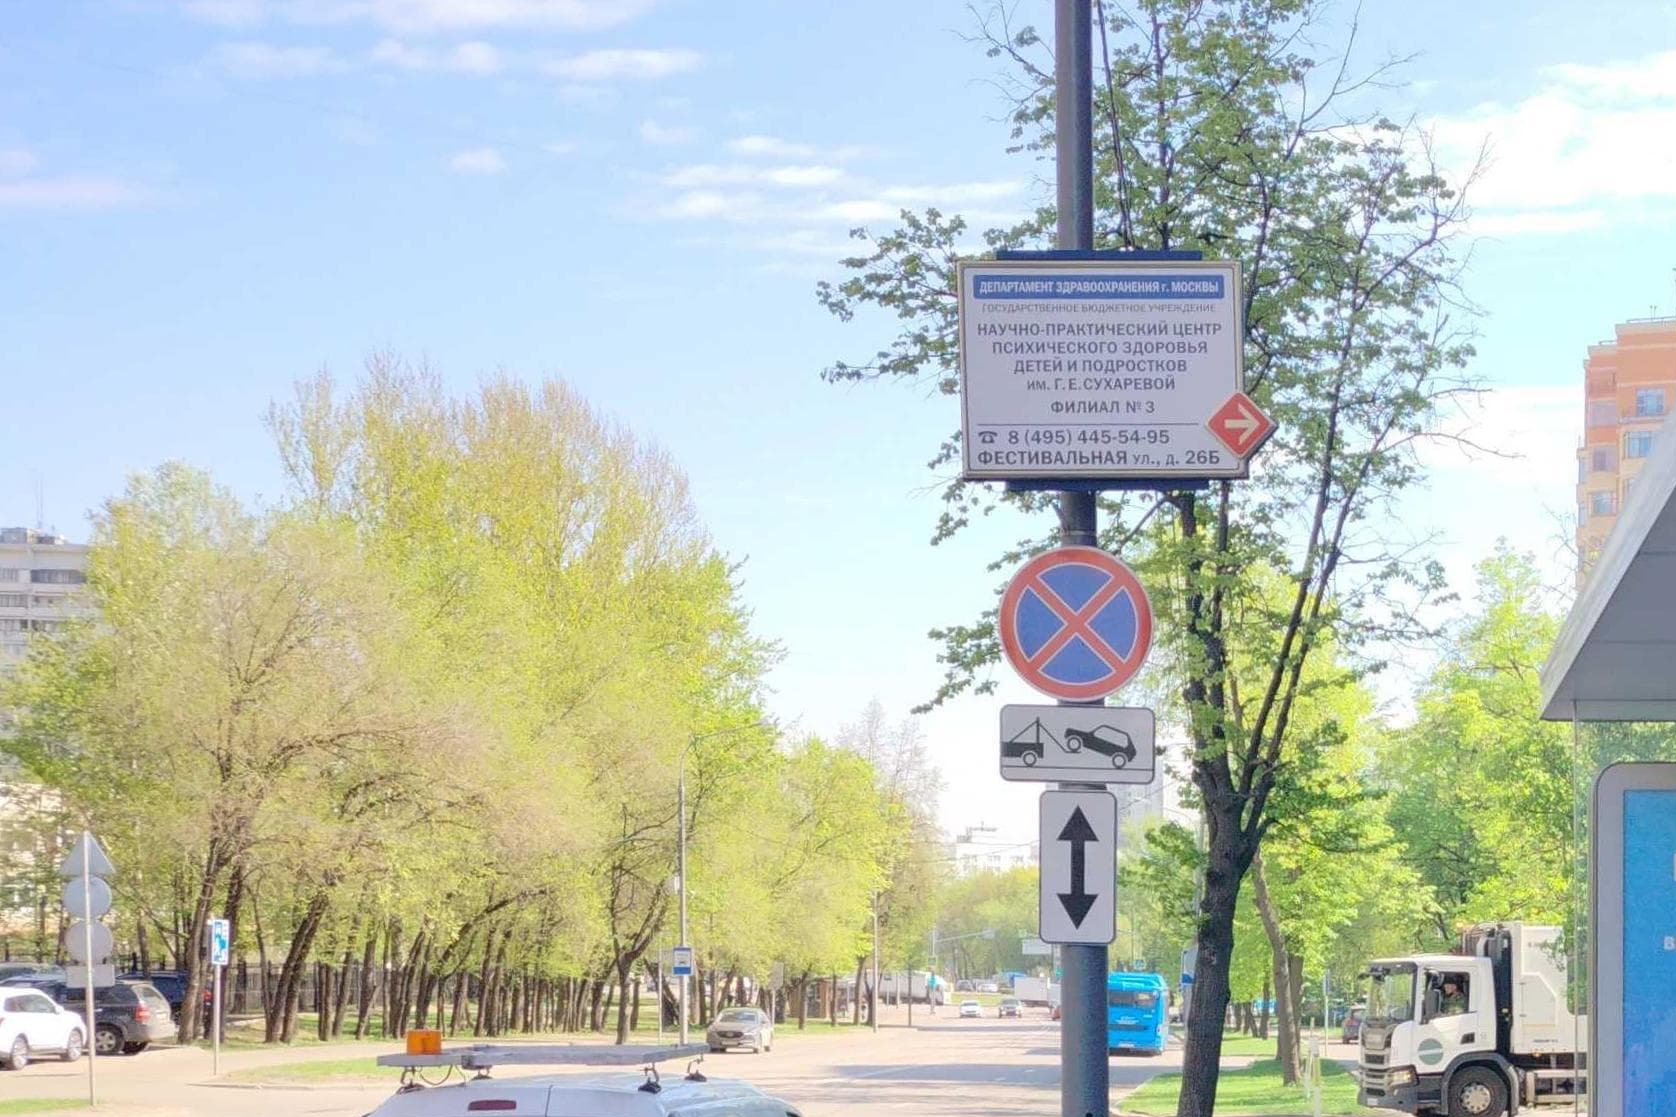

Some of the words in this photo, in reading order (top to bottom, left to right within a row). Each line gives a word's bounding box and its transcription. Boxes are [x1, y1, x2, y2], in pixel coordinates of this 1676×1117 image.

[979, 281, 1053, 294] ДЕПАРТАМЕНТ
[1055, 281, 1160, 294] ЗДРАВООХРАНЕНИЯ
[1171, 281, 1219, 292] МОСКВЫ
[982, 303, 1079, 313] ГОСУДАРСТВЕННОЕ
[1081, 303, 1146, 313] БЮДЖЕТНОЕ
[1148, 303, 1216, 313] УЧРЕЖДЕНИЕ
[977, 320, 1168, 336] НАУЧНО-ПРАКТИЧЕСКИЙ
[1173, 323, 1222, 337] ЦЕНТР
[992, 341, 1118, 354] ПСИХИЧЕСКОГО
[1122, 341, 1208, 356] ЗДОРОВЬЯ
[1014, 357, 1062, 374] ДЕТЕЙ
[1067, 360, 1078, 372] И
[1082, 359, 1188, 374] ПОДРОСТКОВ
[1050, 400, 1120, 413] ФИЛИАЛ
[1145, 400, 1155, 413] 3
[1008, 429, 1019, 444] 8
[1025, 429, 1072, 446] (495)
[1077, 429, 1170, 444] 445-54-95
[977, 449, 1128, 465] ФЕСТИВАЛЬНАЯ
[1185, 449, 1220, 465] 26Б
